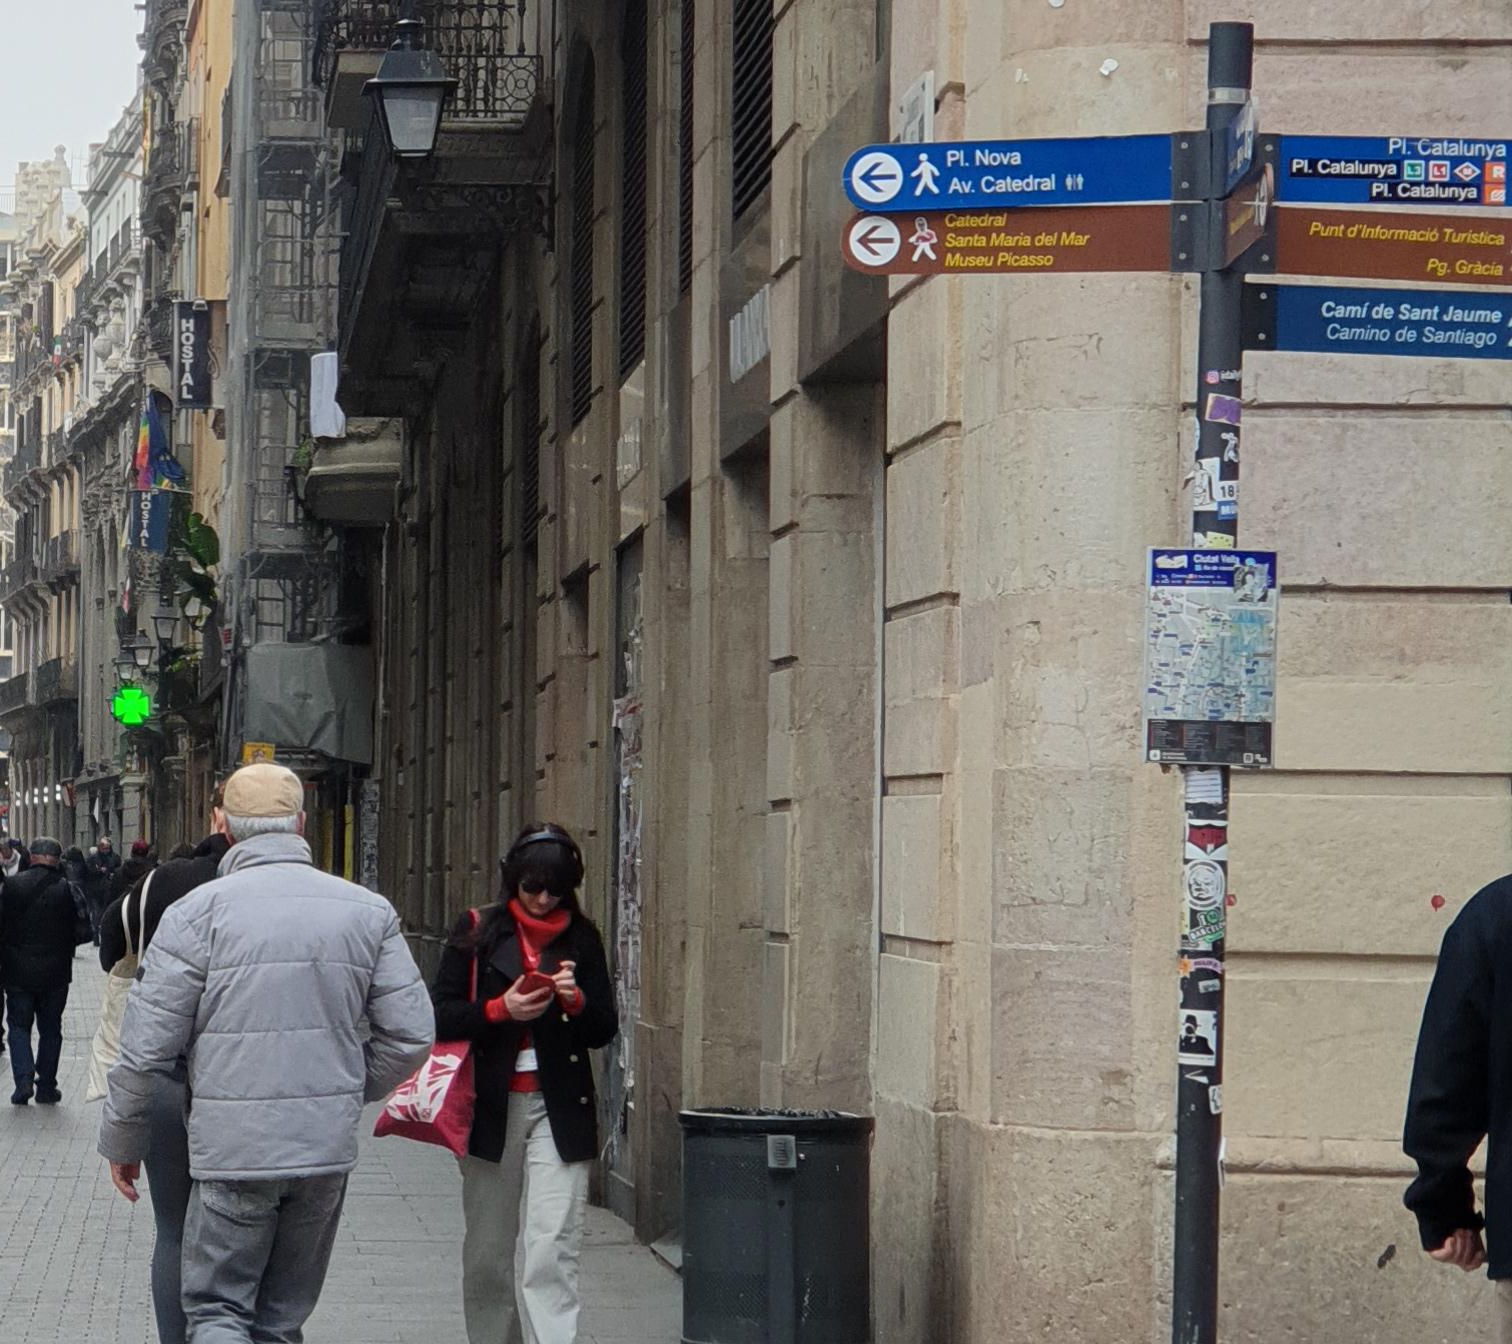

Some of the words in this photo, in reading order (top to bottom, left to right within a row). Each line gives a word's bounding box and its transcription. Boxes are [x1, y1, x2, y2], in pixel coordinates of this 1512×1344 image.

[946, 150, 969, 167] Pl.
[975, 149, 1022, 166] Nova
[1389, 138, 1411, 155] Pl.
[1417, 138, 1507, 161] Catalunya
[1292, 158, 1312, 174] Pl.
[1317, 159, 1397, 178] Catalunya
[948, 177, 975, 194] Av.
[981, 173, 1056, 193] Catedral
[1372, 182, 1392, 197] Pl.
[1397, 183, 1478, 201] Catalunya
[945, 213, 1007, 227] Catedral
[945, 233, 986, 248] Santa
[990, 232, 1031, 247] Maria
[1035, 232, 1057, 247] del
[1060, 232, 1090, 247] Mar
[1310, 222, 1345, 237] Punt
[1347, 223, 1439, 242] d'Informació
[945, 253, 993, 267] Museu
[997, 252, 1054, 267] Picasso
[1427, 258, 1450, 277] Pg.
[1455, 259, 1503, 276] Gràcia
[1321, 301, 1370, 319] Camí
[1371, 304, 1394, 319] de
[1398, 304, 1439, 321] Sant
[1442, 306, 1502, 323] Jaume
[1327, 323, 1390, 341] Camino
[1395, 326, 1418, 343] de
[1422, 326, 1497, 348] Santiago
[180, 318, 195, 399] HOSTAL
[139, 492, 152, 548] HOSTAL
